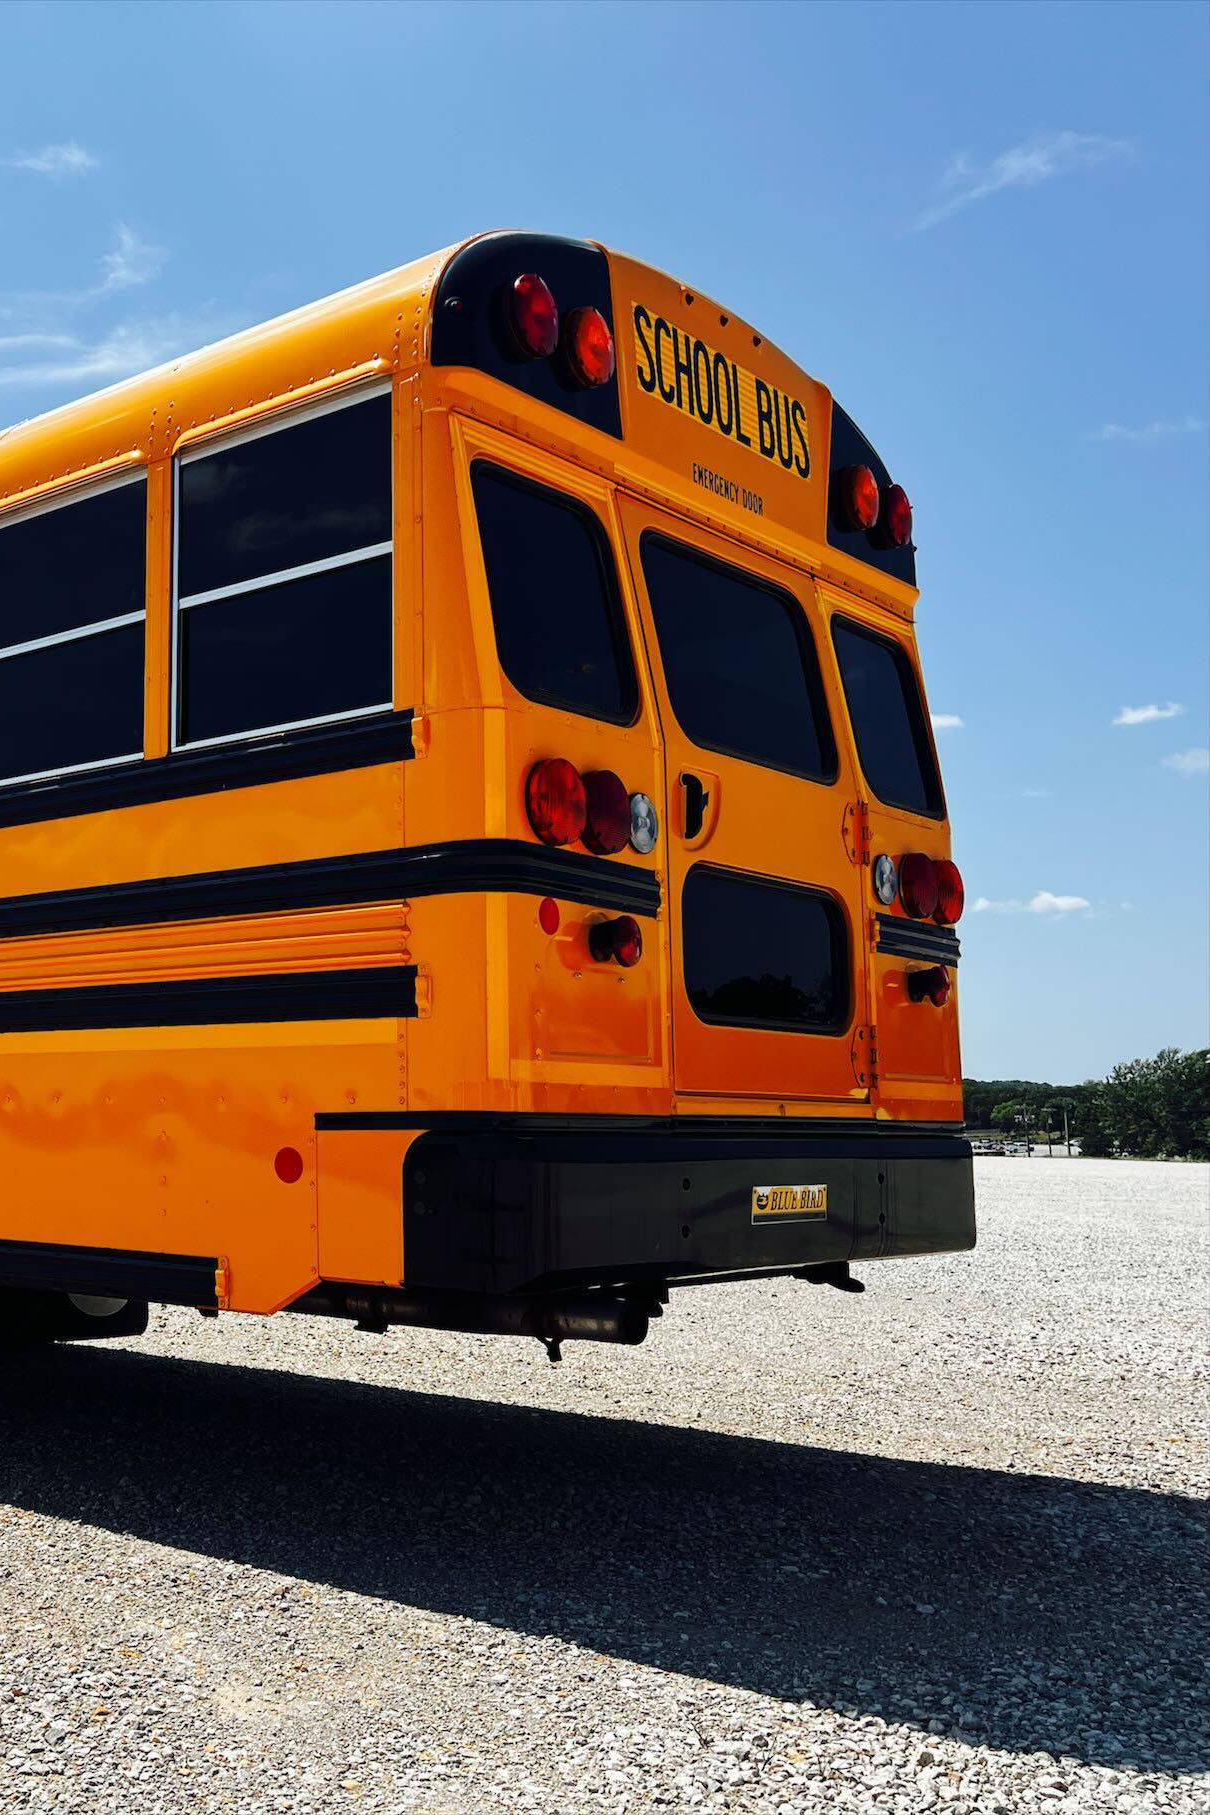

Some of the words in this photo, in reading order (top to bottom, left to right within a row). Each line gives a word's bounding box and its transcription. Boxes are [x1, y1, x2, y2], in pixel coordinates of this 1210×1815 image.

[633, 303, 751, 447] SCHOOL
[755, 376, 811, 479] BUS
[692, 462, 739, 504] EMERGENCY
[742, 488, 763, 516] DOOR
[771, 1190, 797, 1211] BLUE
[800, 1189, 824, 1209] BIRD
